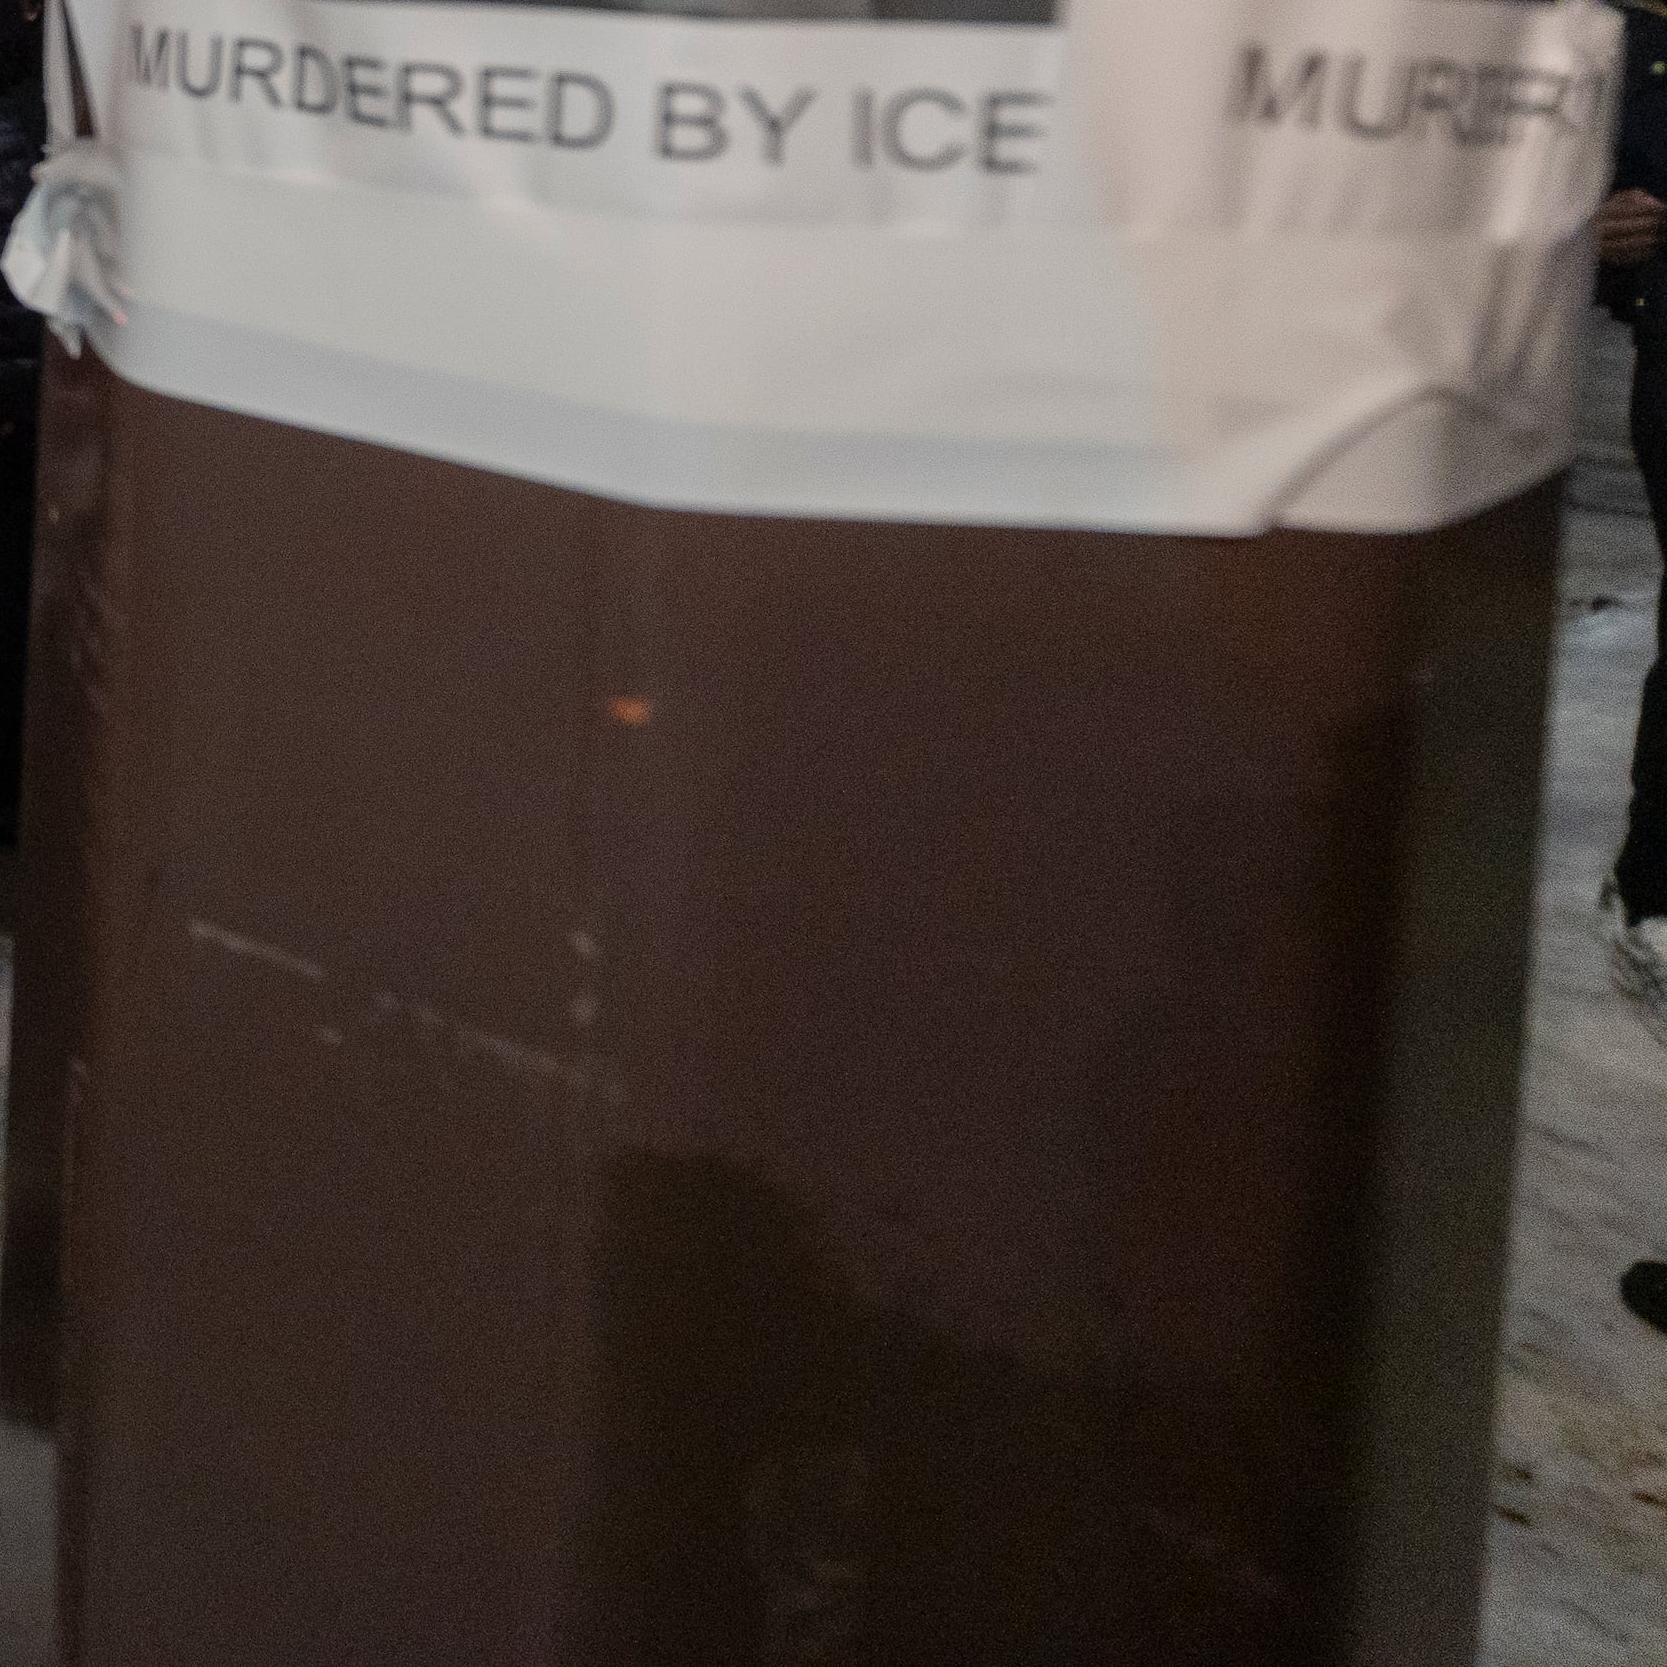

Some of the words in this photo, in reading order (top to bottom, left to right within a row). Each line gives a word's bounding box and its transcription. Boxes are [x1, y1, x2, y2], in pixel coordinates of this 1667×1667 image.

[132, 23, 616, 151] MURDERED
[653, 79, 819, 168] BY
[851, 84, 1057, 176] ICE
